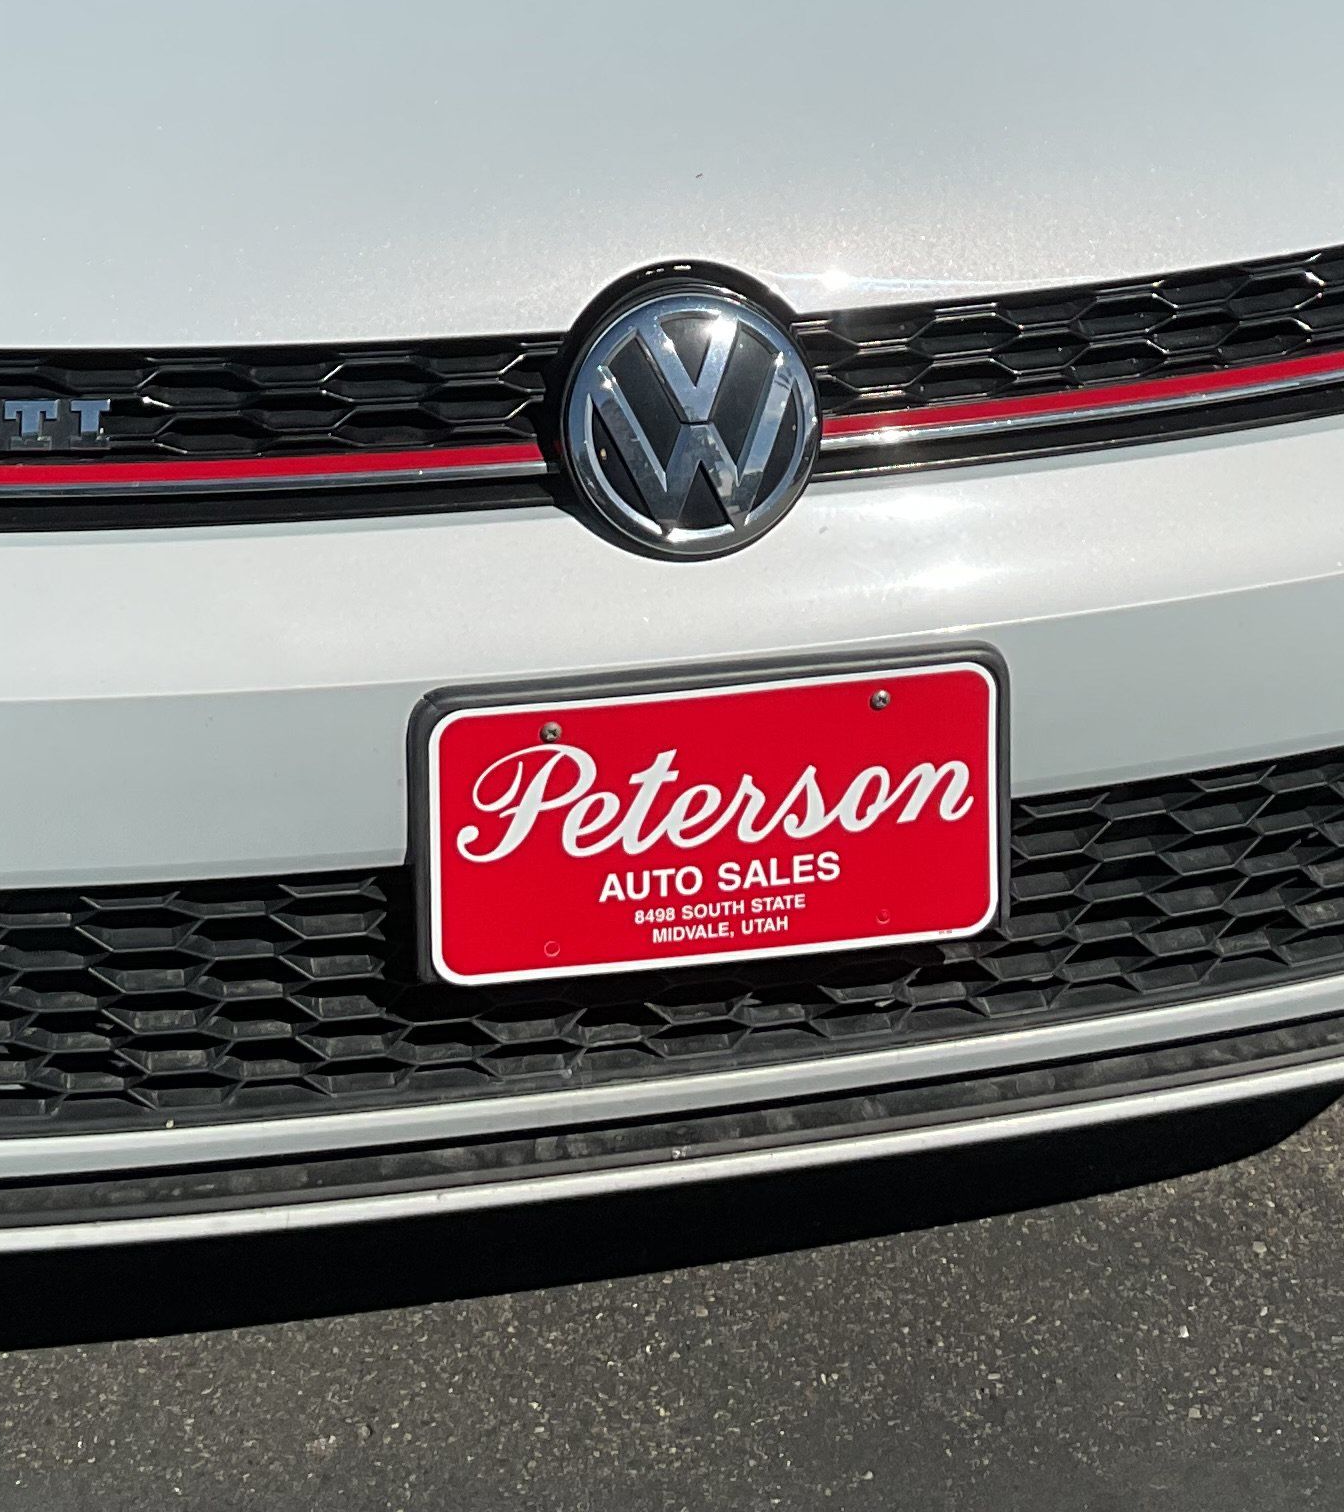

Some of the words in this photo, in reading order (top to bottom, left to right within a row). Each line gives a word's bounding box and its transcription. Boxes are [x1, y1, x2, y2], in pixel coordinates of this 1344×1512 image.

[456, 744, 975, 863] Peterson
[599, 865, 703, 903] AUTO
[717, 851, 841, 892] SALES
[634, 907, 676, 925] 8498
[681, 899, 745, 920] SOUTH
[751, 893, 806, 914] STATE
[652, 921, 735, 944] MIDVALE,
[741, 915, 789, 936] UTAH
